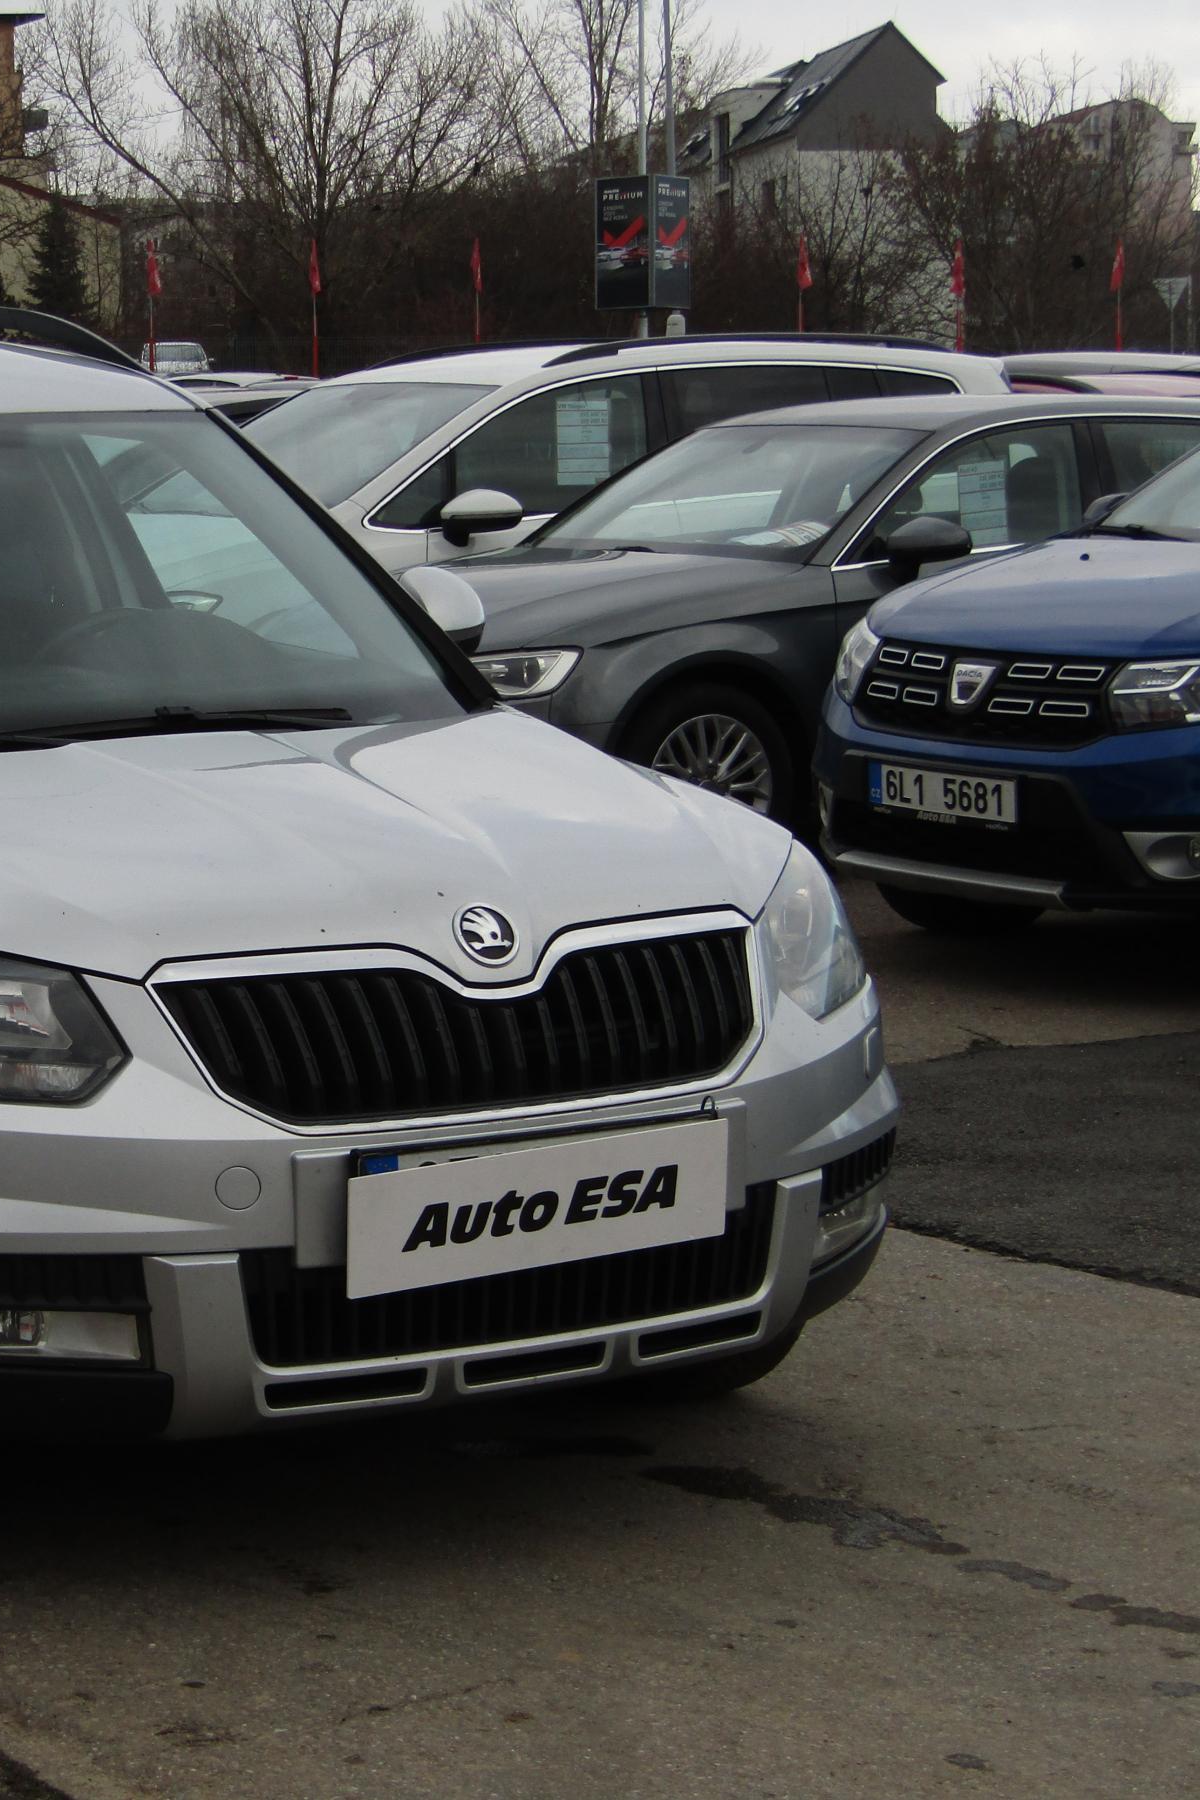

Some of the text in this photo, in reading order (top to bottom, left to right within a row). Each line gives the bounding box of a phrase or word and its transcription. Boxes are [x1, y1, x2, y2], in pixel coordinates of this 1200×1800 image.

[886, 770, 924, 806] 6L1
[943, 778, 1003, 817] 5681
[401, 1164, 679, 1253] Auto ESA
